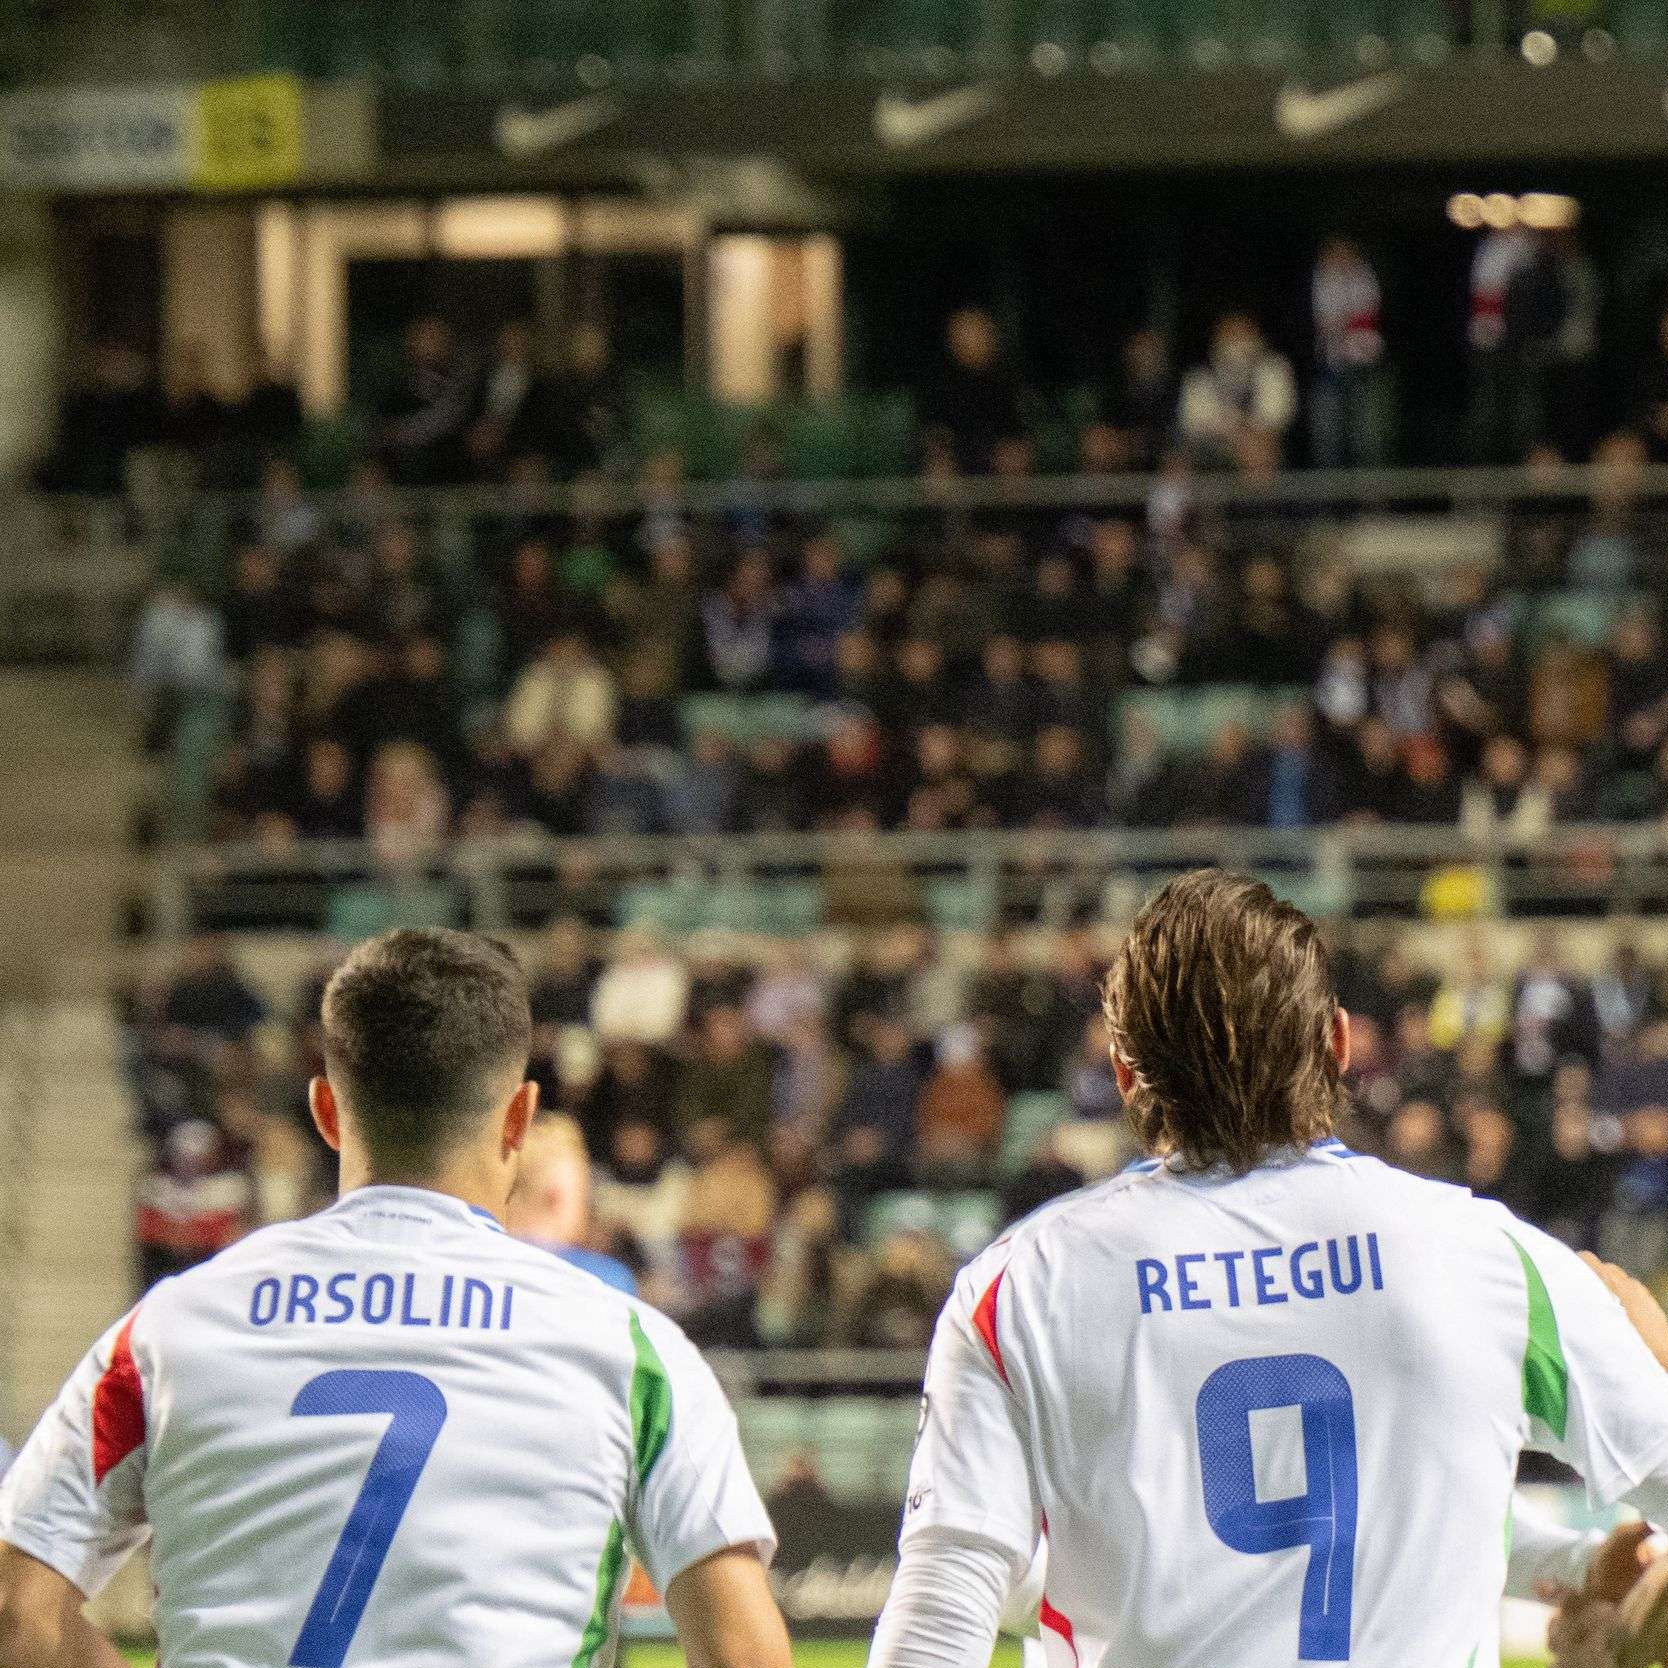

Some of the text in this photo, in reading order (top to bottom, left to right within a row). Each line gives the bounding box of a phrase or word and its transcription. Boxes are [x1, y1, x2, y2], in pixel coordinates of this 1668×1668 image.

[249, 1273, 514, 1330] ORSOLINI
[1135, 1232, 1384, 1314] RETEGUI
[1195, 1352, 1359, 1661] 9
